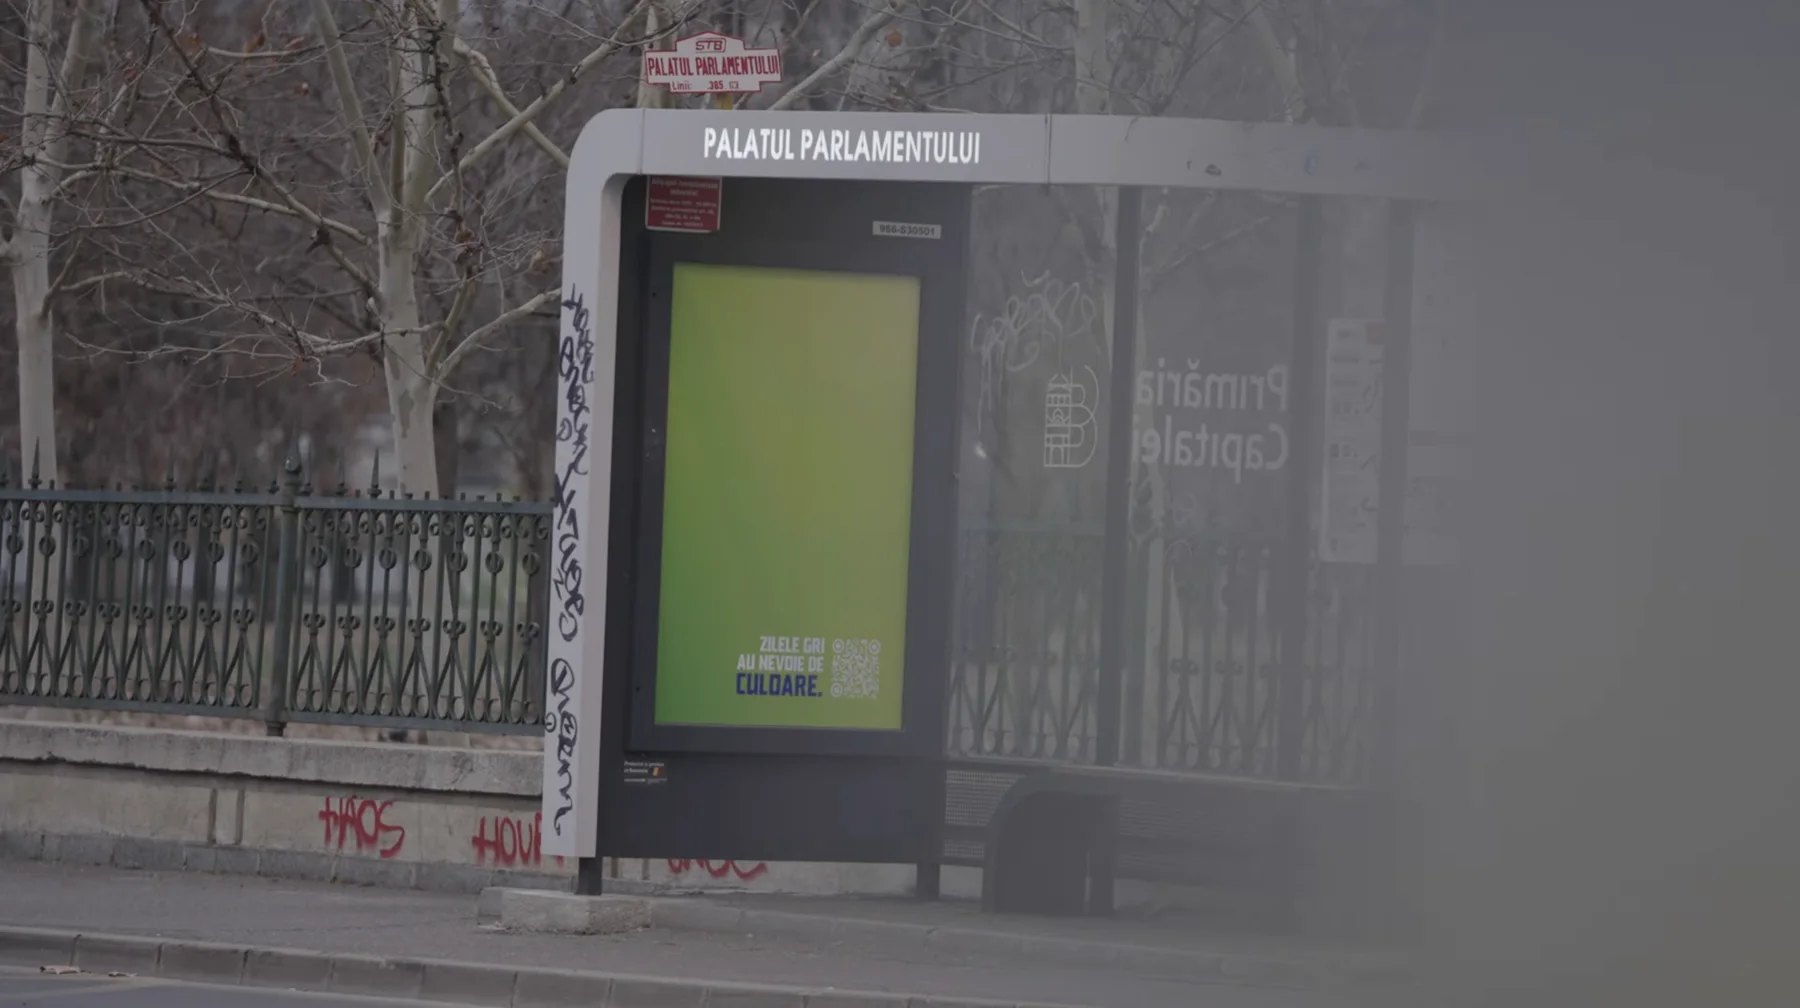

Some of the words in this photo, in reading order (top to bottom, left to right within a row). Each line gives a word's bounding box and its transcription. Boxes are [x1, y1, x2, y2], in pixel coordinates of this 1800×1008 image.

[695, 40, 723, 51] STB
[647, 57, 694, 76] PALATUL
[695, 55, 779, 76] PARLAMENTULUI
[703, 127, 794, 160] PALATUL
[800, 129, 981, 164] PARLAMENTULUI
[759, 636, 800, 653] ZILELE
[803, 637, 825, 654] GRI
[736, 654, 755, 671] AU
[758, 655, 804, 672] NEVOIE
[807, 656, 824, 673] DE
[736, 673, 823, 698] CULOARE.
